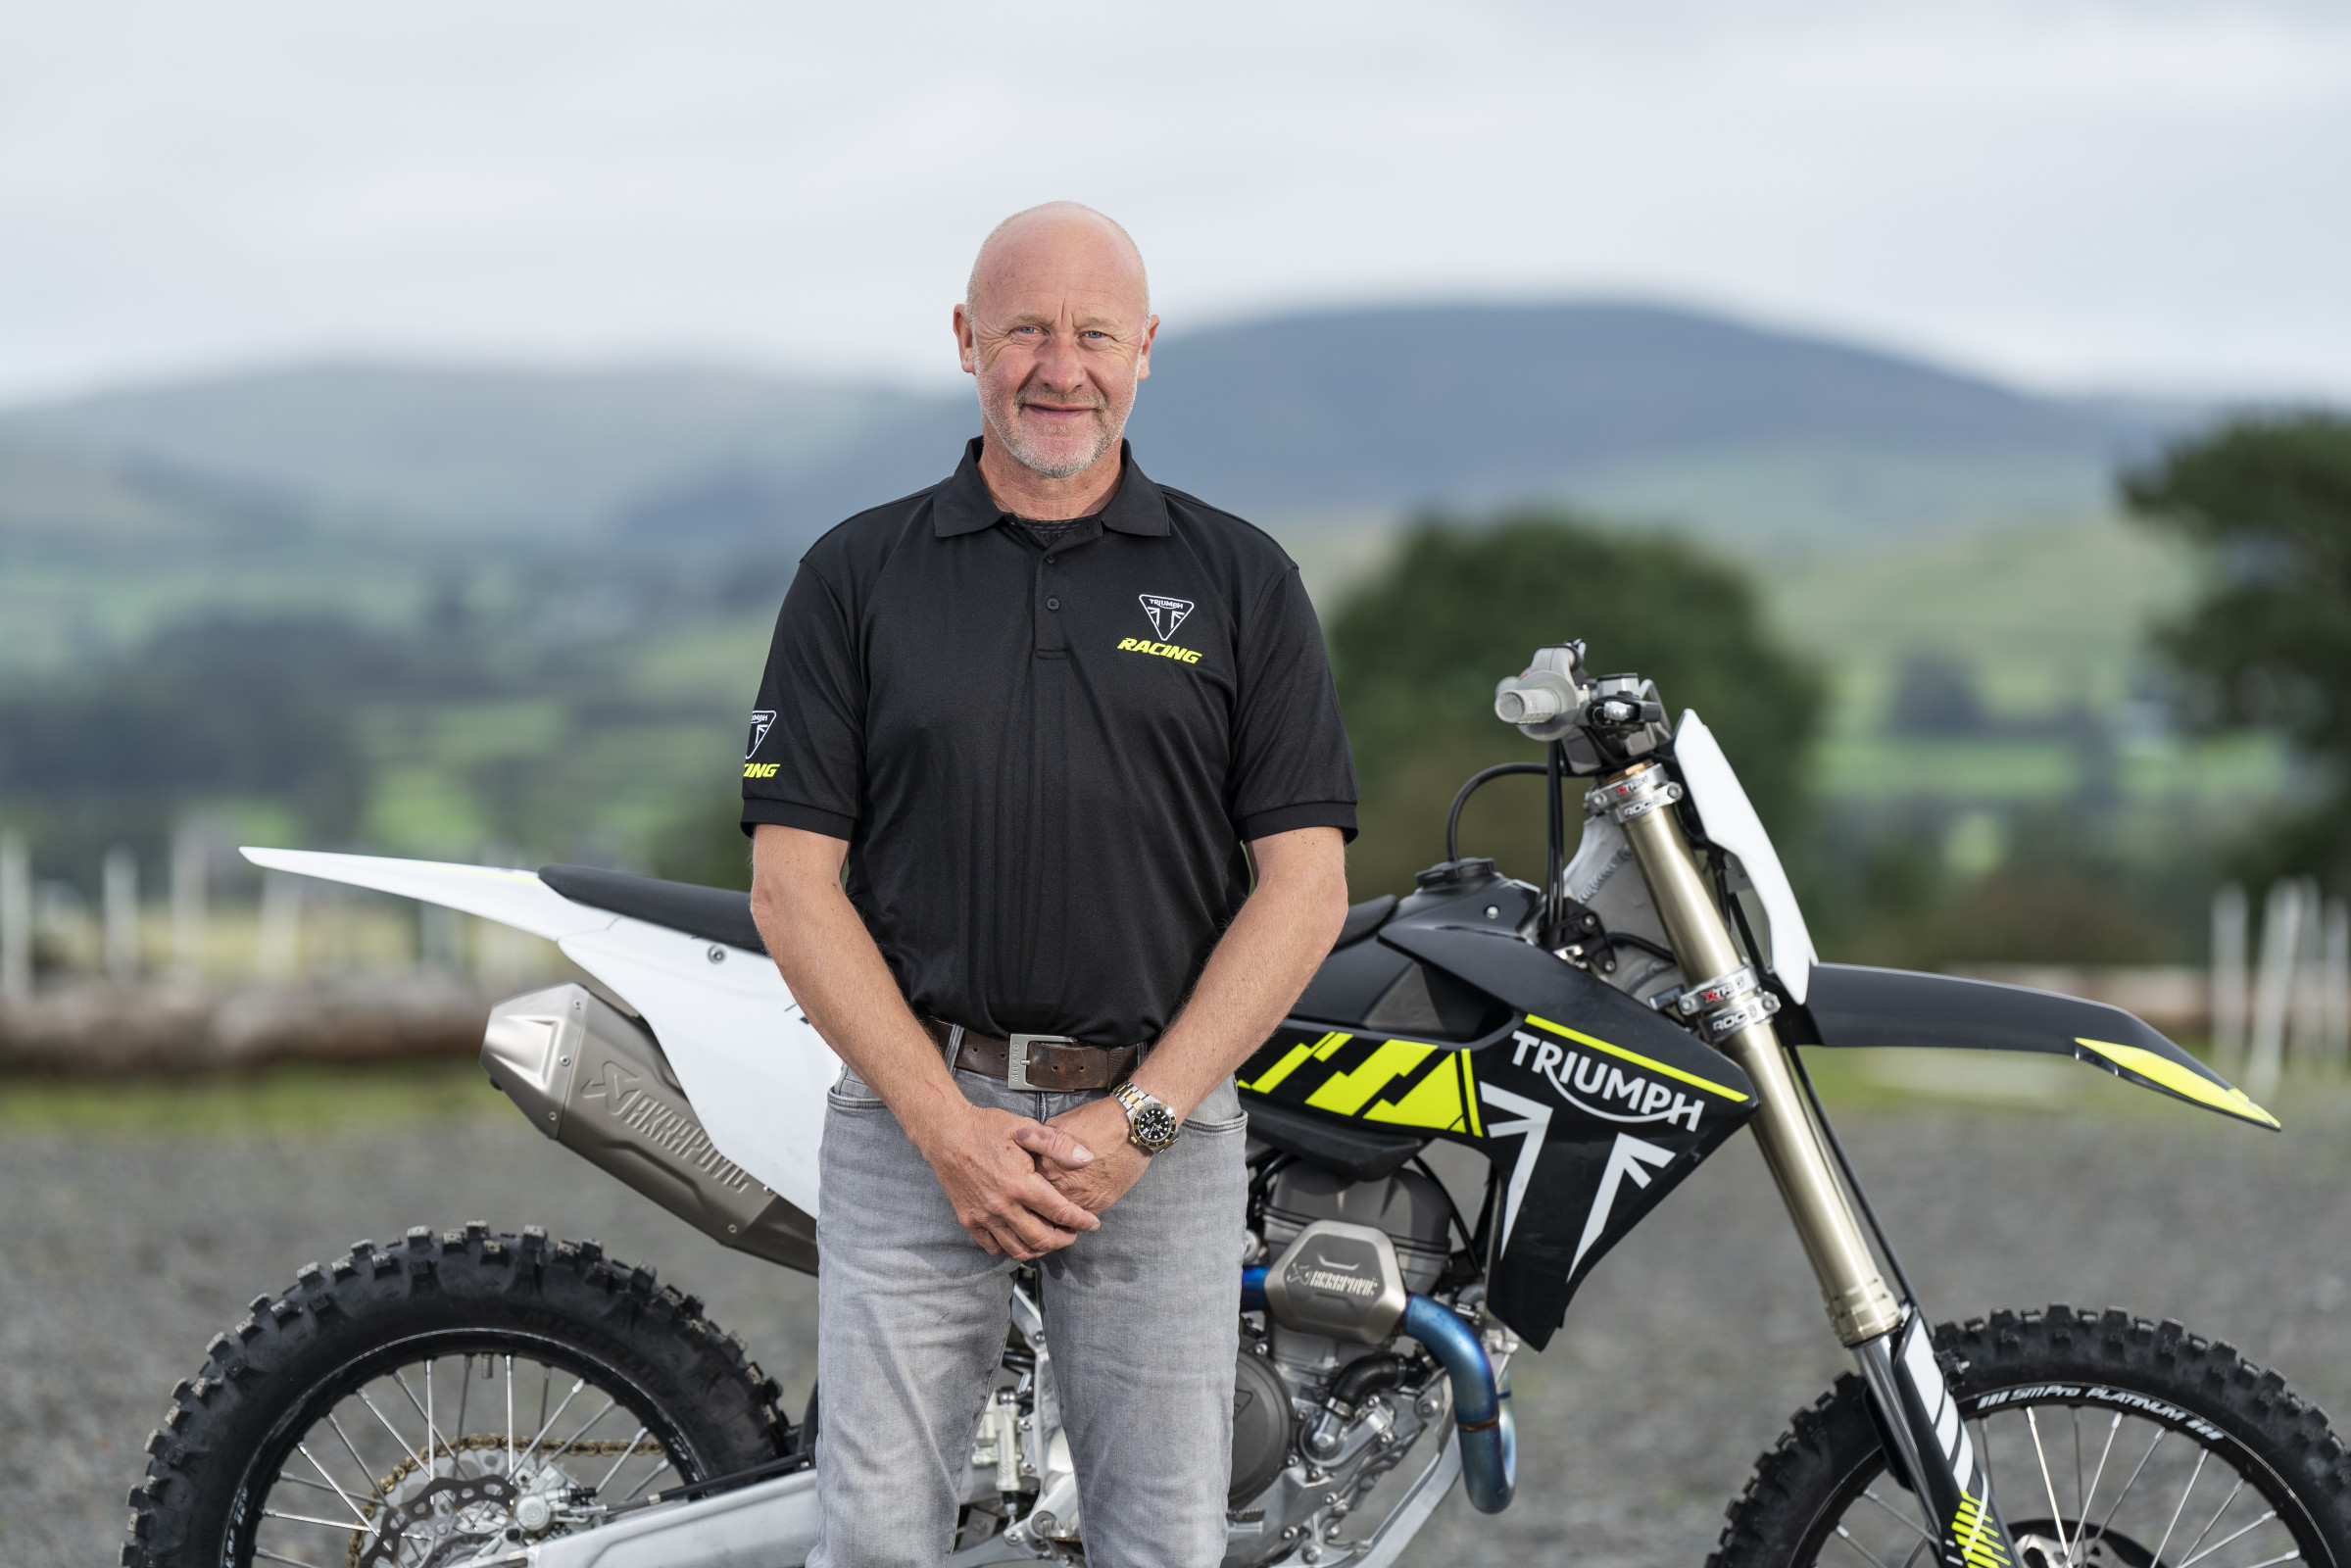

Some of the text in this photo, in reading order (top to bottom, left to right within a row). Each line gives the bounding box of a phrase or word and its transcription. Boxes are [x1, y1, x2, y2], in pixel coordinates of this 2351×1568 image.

[1149, 598, 1184, 610] TRIUMPH
[1117, 637, 1202, 664] RACING
[1512, 1030, 1705, 1133] TRIUMPH
[2085, 1387, 2187, 1421] PLATINUM
